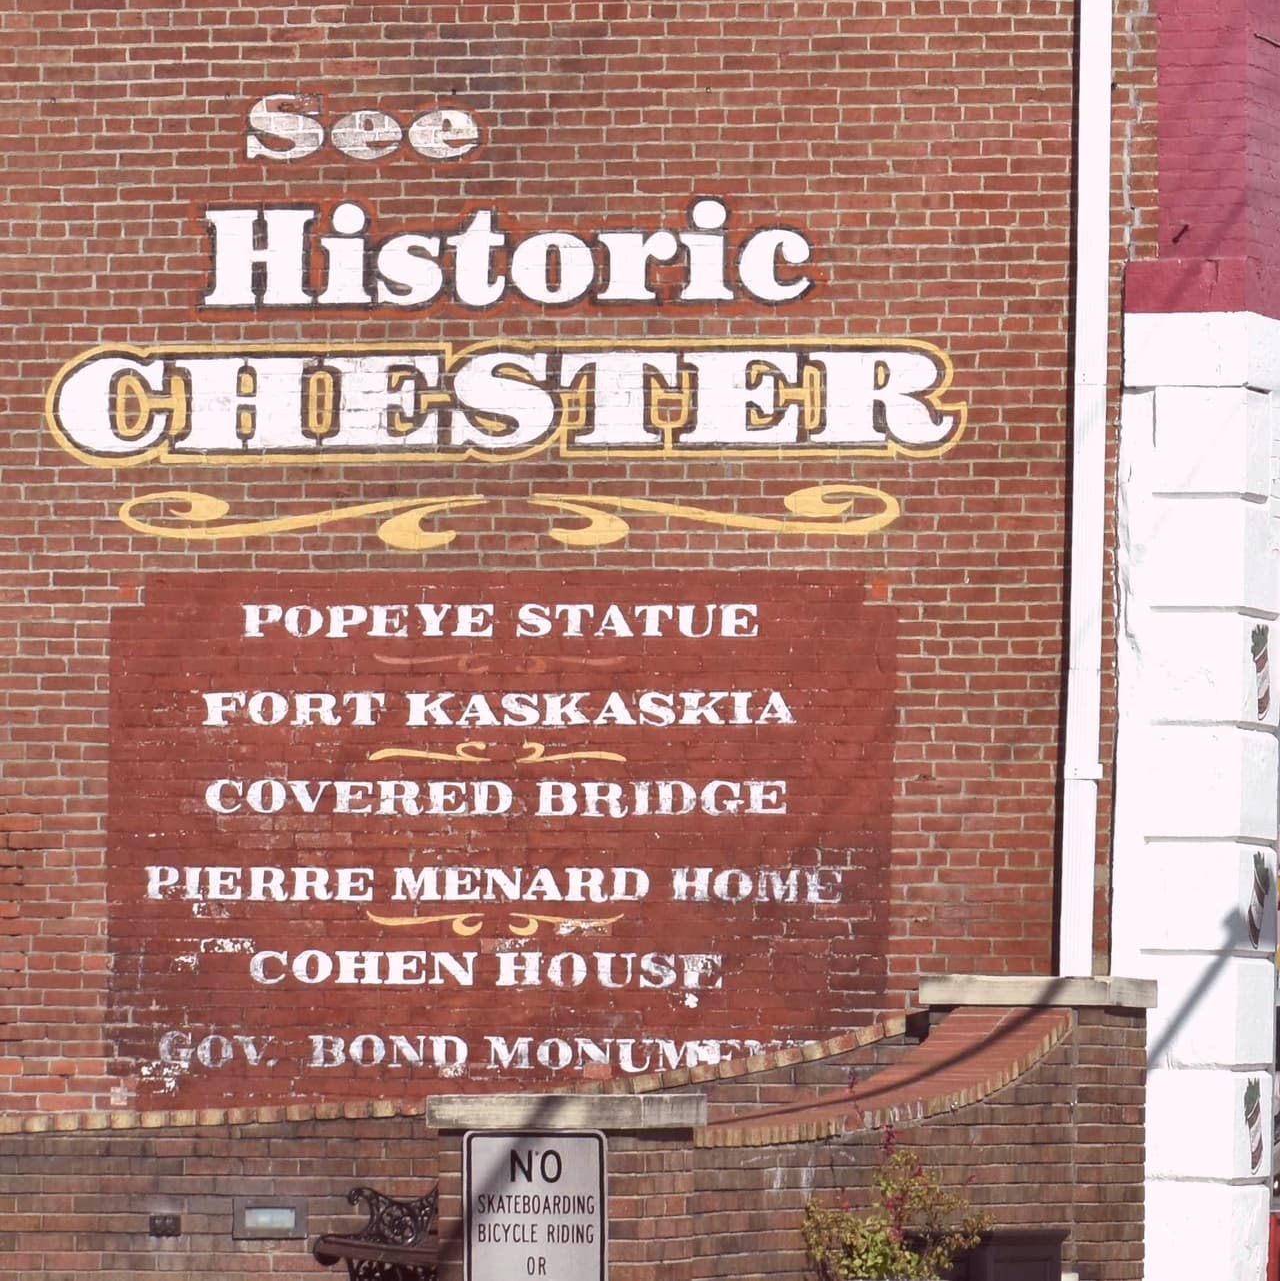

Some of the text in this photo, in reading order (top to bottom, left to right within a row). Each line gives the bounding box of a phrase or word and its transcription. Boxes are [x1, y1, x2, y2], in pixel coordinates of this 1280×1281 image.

[245, 93, 480, 161] See
[202, 200, 813, 308] Historic
[54, 348, 957, 453] CHESTER
[240, 603, 761, 639] POPEYE STATUE
[200, 690, 798, 728] FORT KASKASKIA
[204, 779, 789, 817] COVERED BRIDGE
[144, 866, 844, 906] PIERRE MENARD HOME
[249, 950, 724, 990] COHEN HOUSE
[157, 1030, 818, 1074] GOV. BOND MONUME
[509, 1149, 563, 1184] NO
[477, 1194, 596, 1215] SKATEBOARDING
[477, 1223, 595, 1245] BICYCLE RIDING
[526, 1255, 547, 1276] OR
